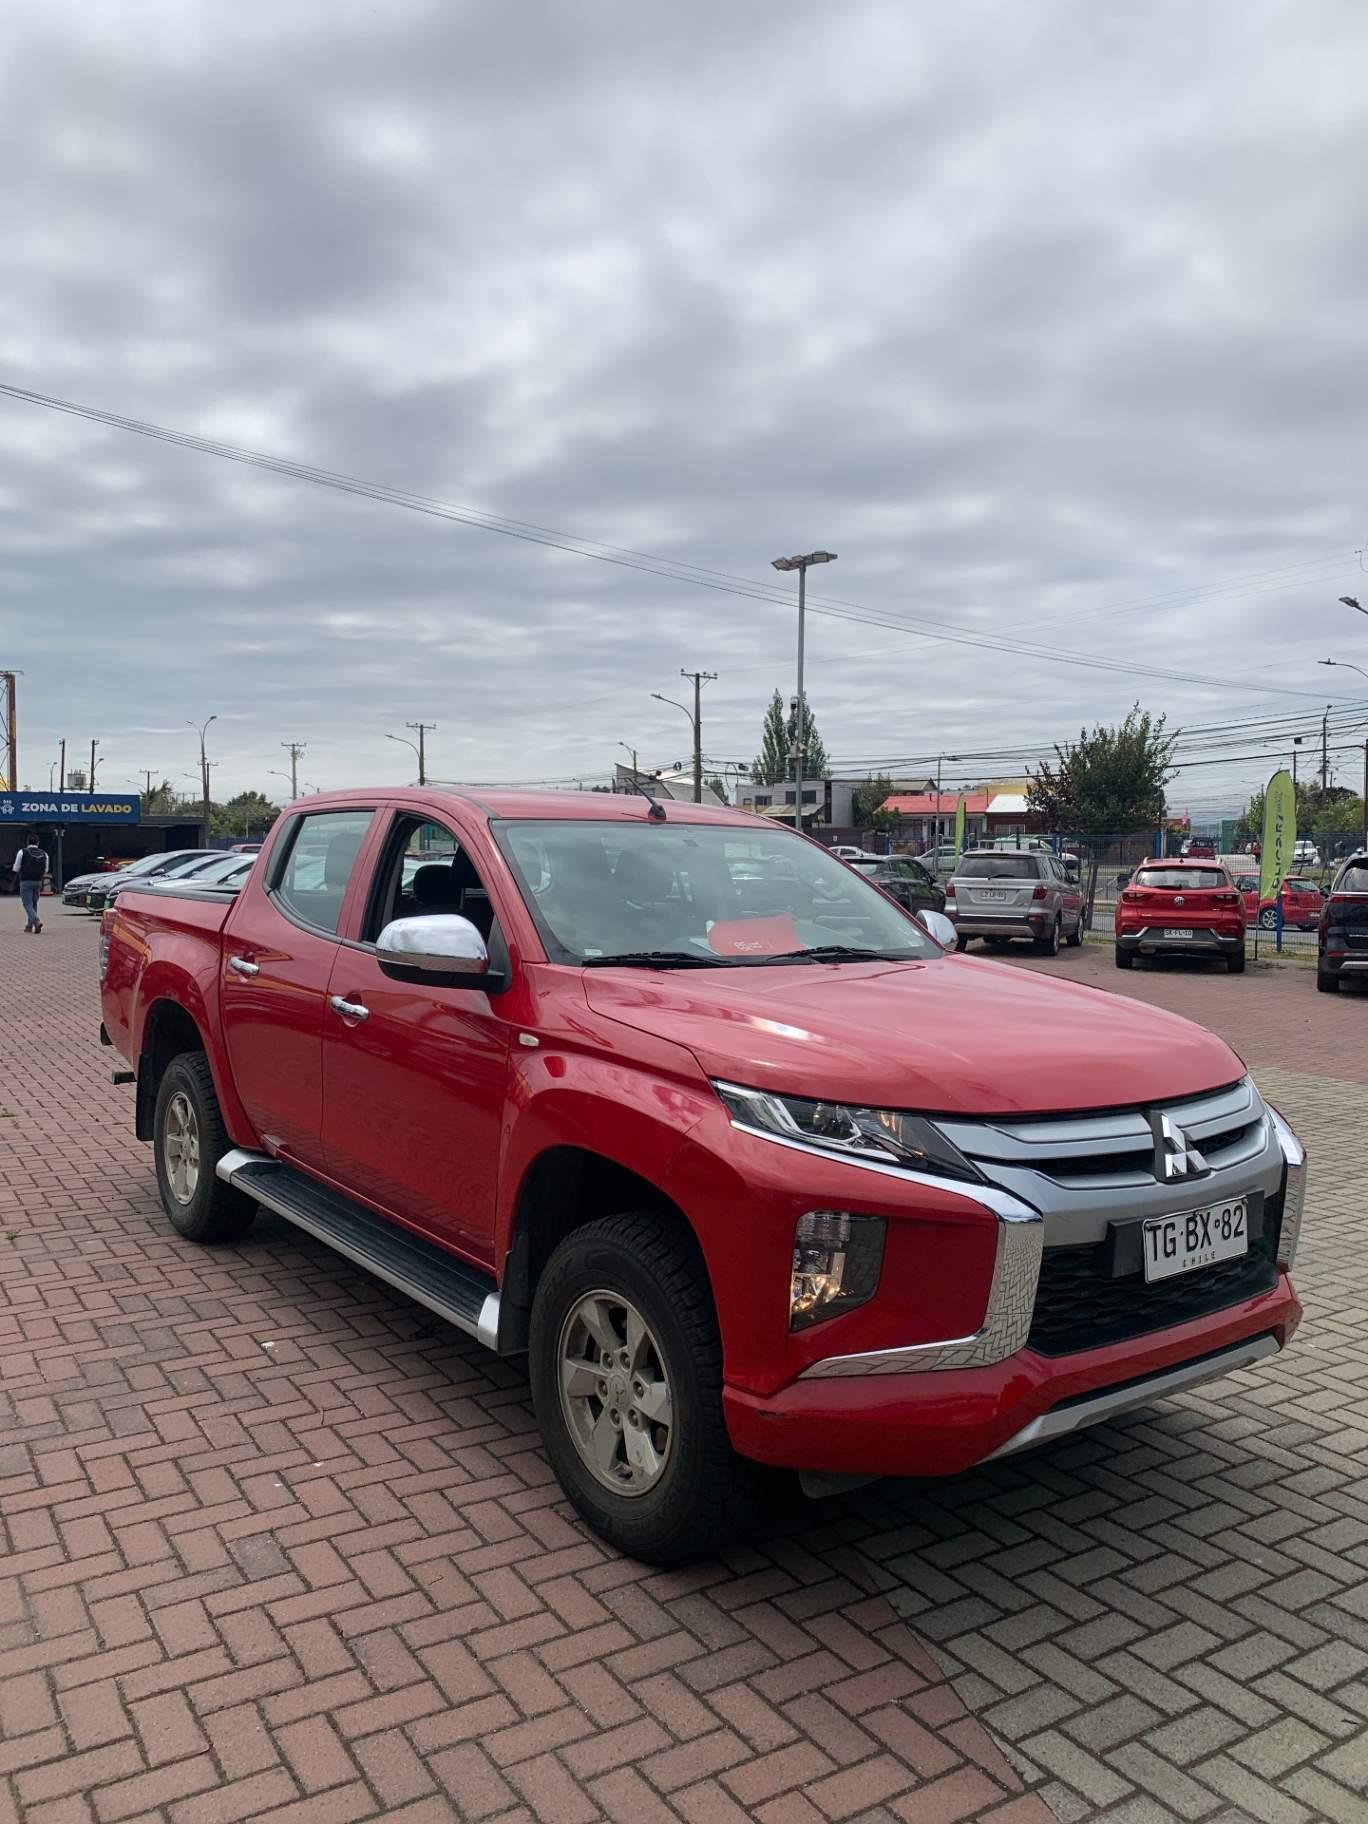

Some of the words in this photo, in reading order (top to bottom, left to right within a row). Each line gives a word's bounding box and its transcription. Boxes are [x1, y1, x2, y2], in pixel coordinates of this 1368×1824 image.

[21, 803, 58, 813] ZONA
[61, 804, 79, 813] DE
[81, 804, 132, 814] LAVADO
[1183, 1251, 1216, 1267] CHILE
